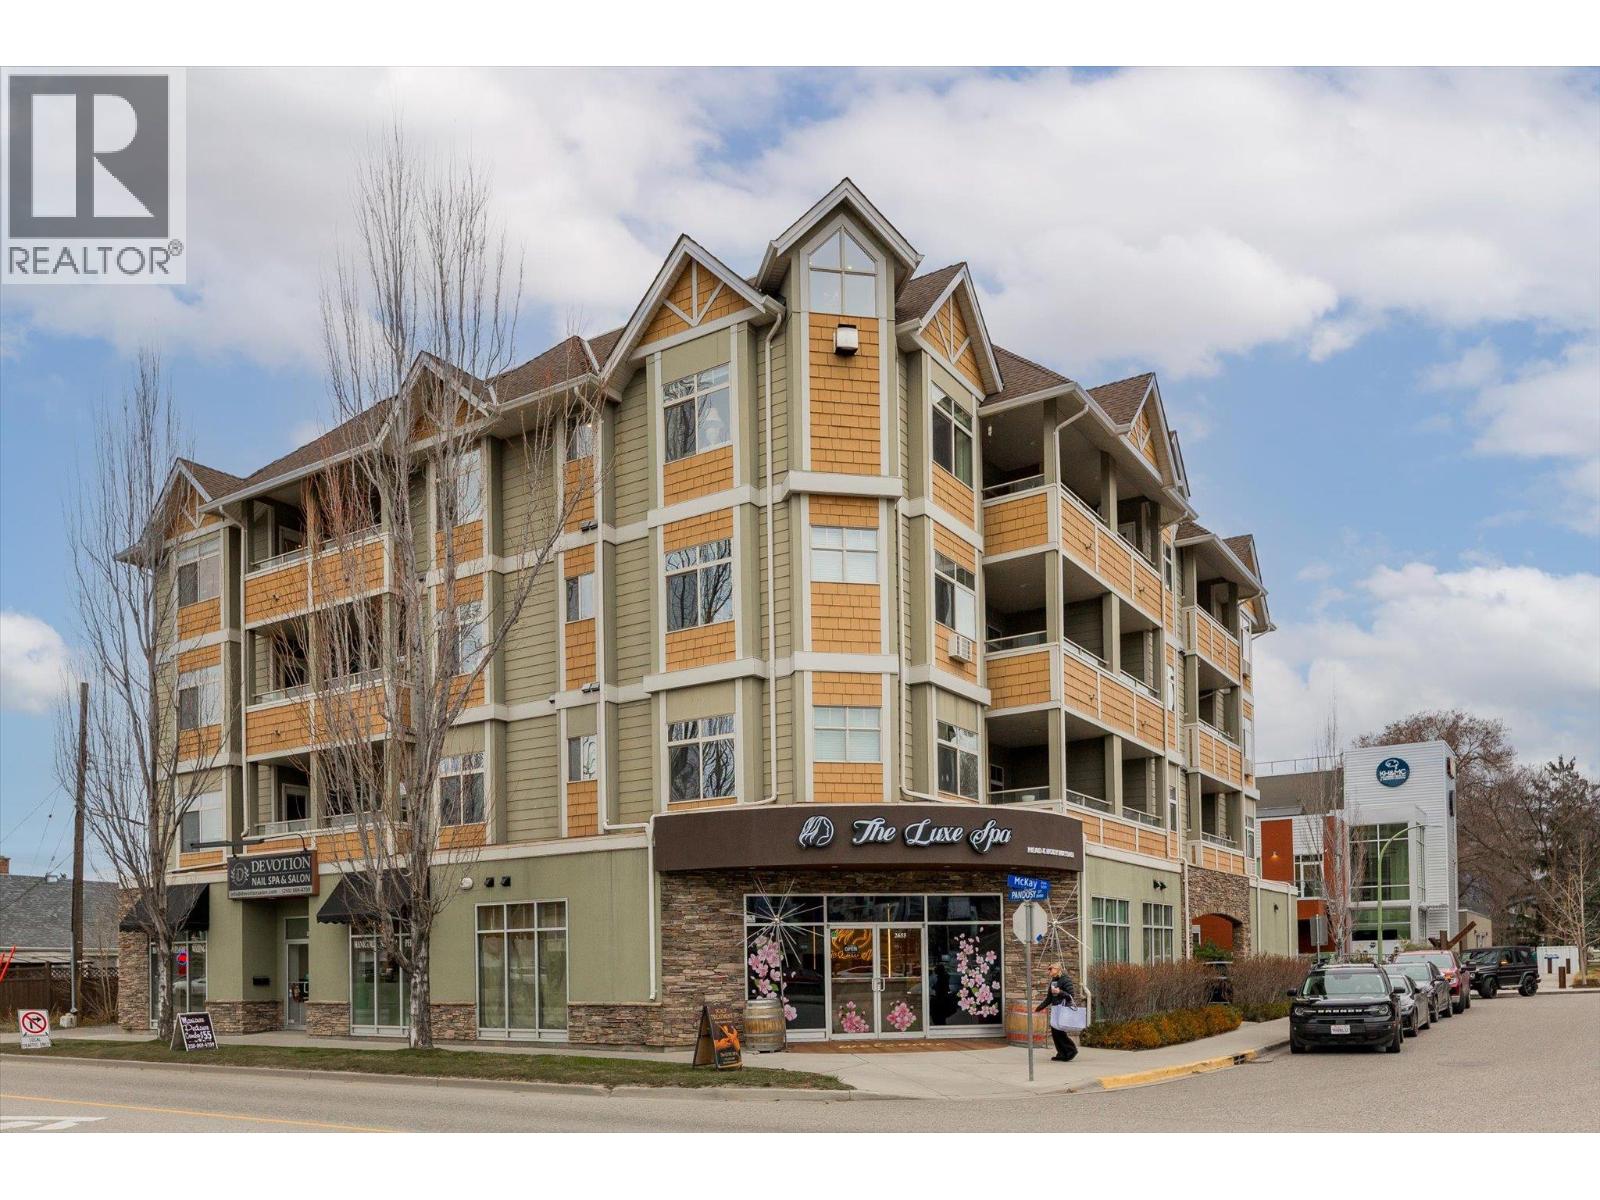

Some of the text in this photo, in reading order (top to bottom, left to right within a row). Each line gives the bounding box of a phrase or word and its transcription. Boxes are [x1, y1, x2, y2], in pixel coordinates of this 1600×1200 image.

[853, 818, 1012, 852] The Luxe Spa
[251, 856, 311, 873] DEVOTION
[251, 873, 312, 886] NAIL SPA & SALON
[1014, 876, 1038, 889] McKay
[1011, 889, 1037, 899] PANDOSY
